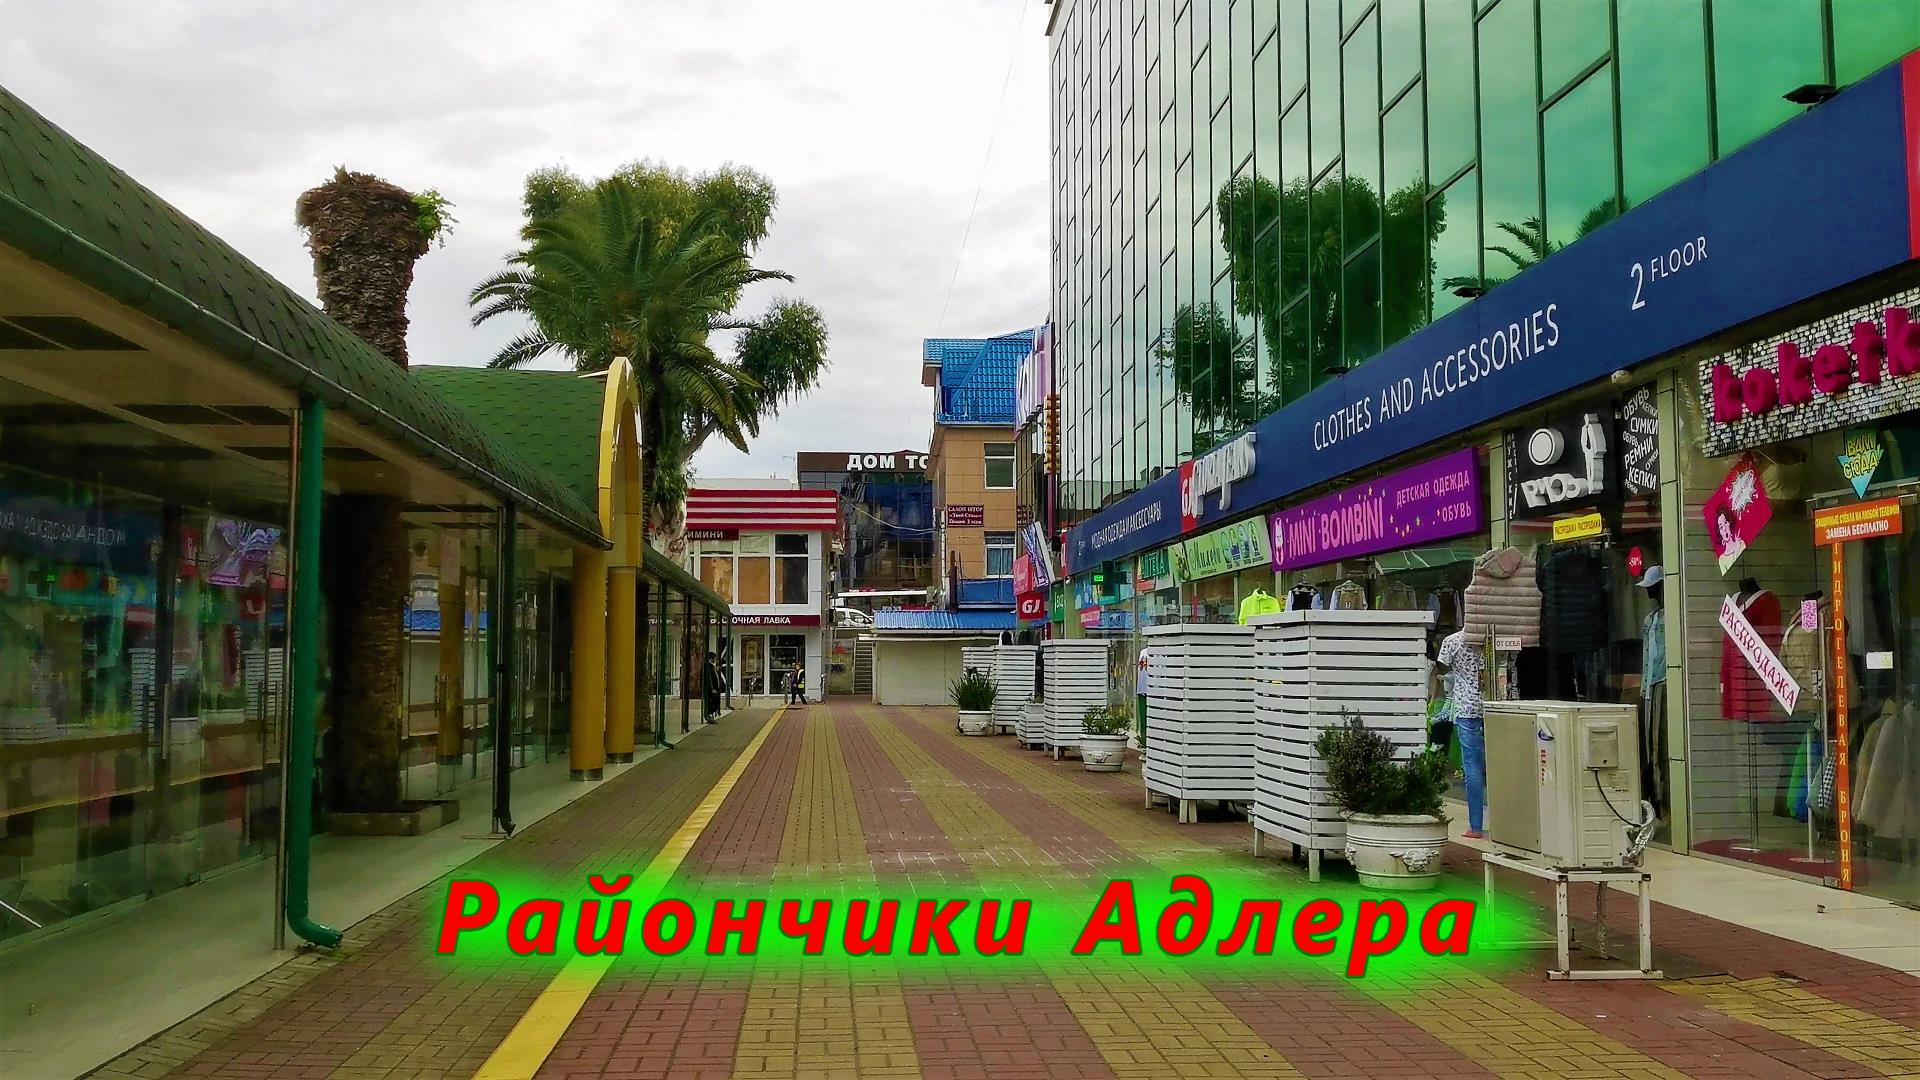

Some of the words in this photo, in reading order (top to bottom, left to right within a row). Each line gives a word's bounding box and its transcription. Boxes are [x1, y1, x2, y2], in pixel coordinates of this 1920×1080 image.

[1630, 262, 1646, 311] 2
[1651, 235, 1709, 283] FLOOR
[1313, 395, 1372, 452] CLOTHES
[1380, 377, 1414, 424] AND
[1420, 303, 1560, 405] ACCESSORIES
[1623, 387, 1650, 421] ОБУВЬ
[1630, 416, 1659, 436] СУМКИ
[847, 454, 895, 471] ДОМ
[1624, 436, 1654, 470] РЕМНИ
[1396, 481, 1430, 509] ДЕТСКАЯ
[1433, 470, 1470, 496] ОДЕЖДА
[1629, 466, 1657, 490] КЕПКИ
[1288, 513, 1317, 561] MINI
[1320, 496, 1384, 551] BOMBINI
[1442, 501, 1472, 523] ОБУВЬ
[1826, 525, 1851, 540] ЗАМЕНА
[1852, 519, 1889, 536] БЕСПЛАТНО
[763, 616, 791, 625] ЛАВКА
[1022, 599, 1041, 614] GJ
[1722, 603, 1796, 709] РАСПРОДАЖА
[1833, 541, 1847, 766] ГИДРОГЕЛЕВАЯ
[1838, 790, 1851, 882] БРОНЯ
